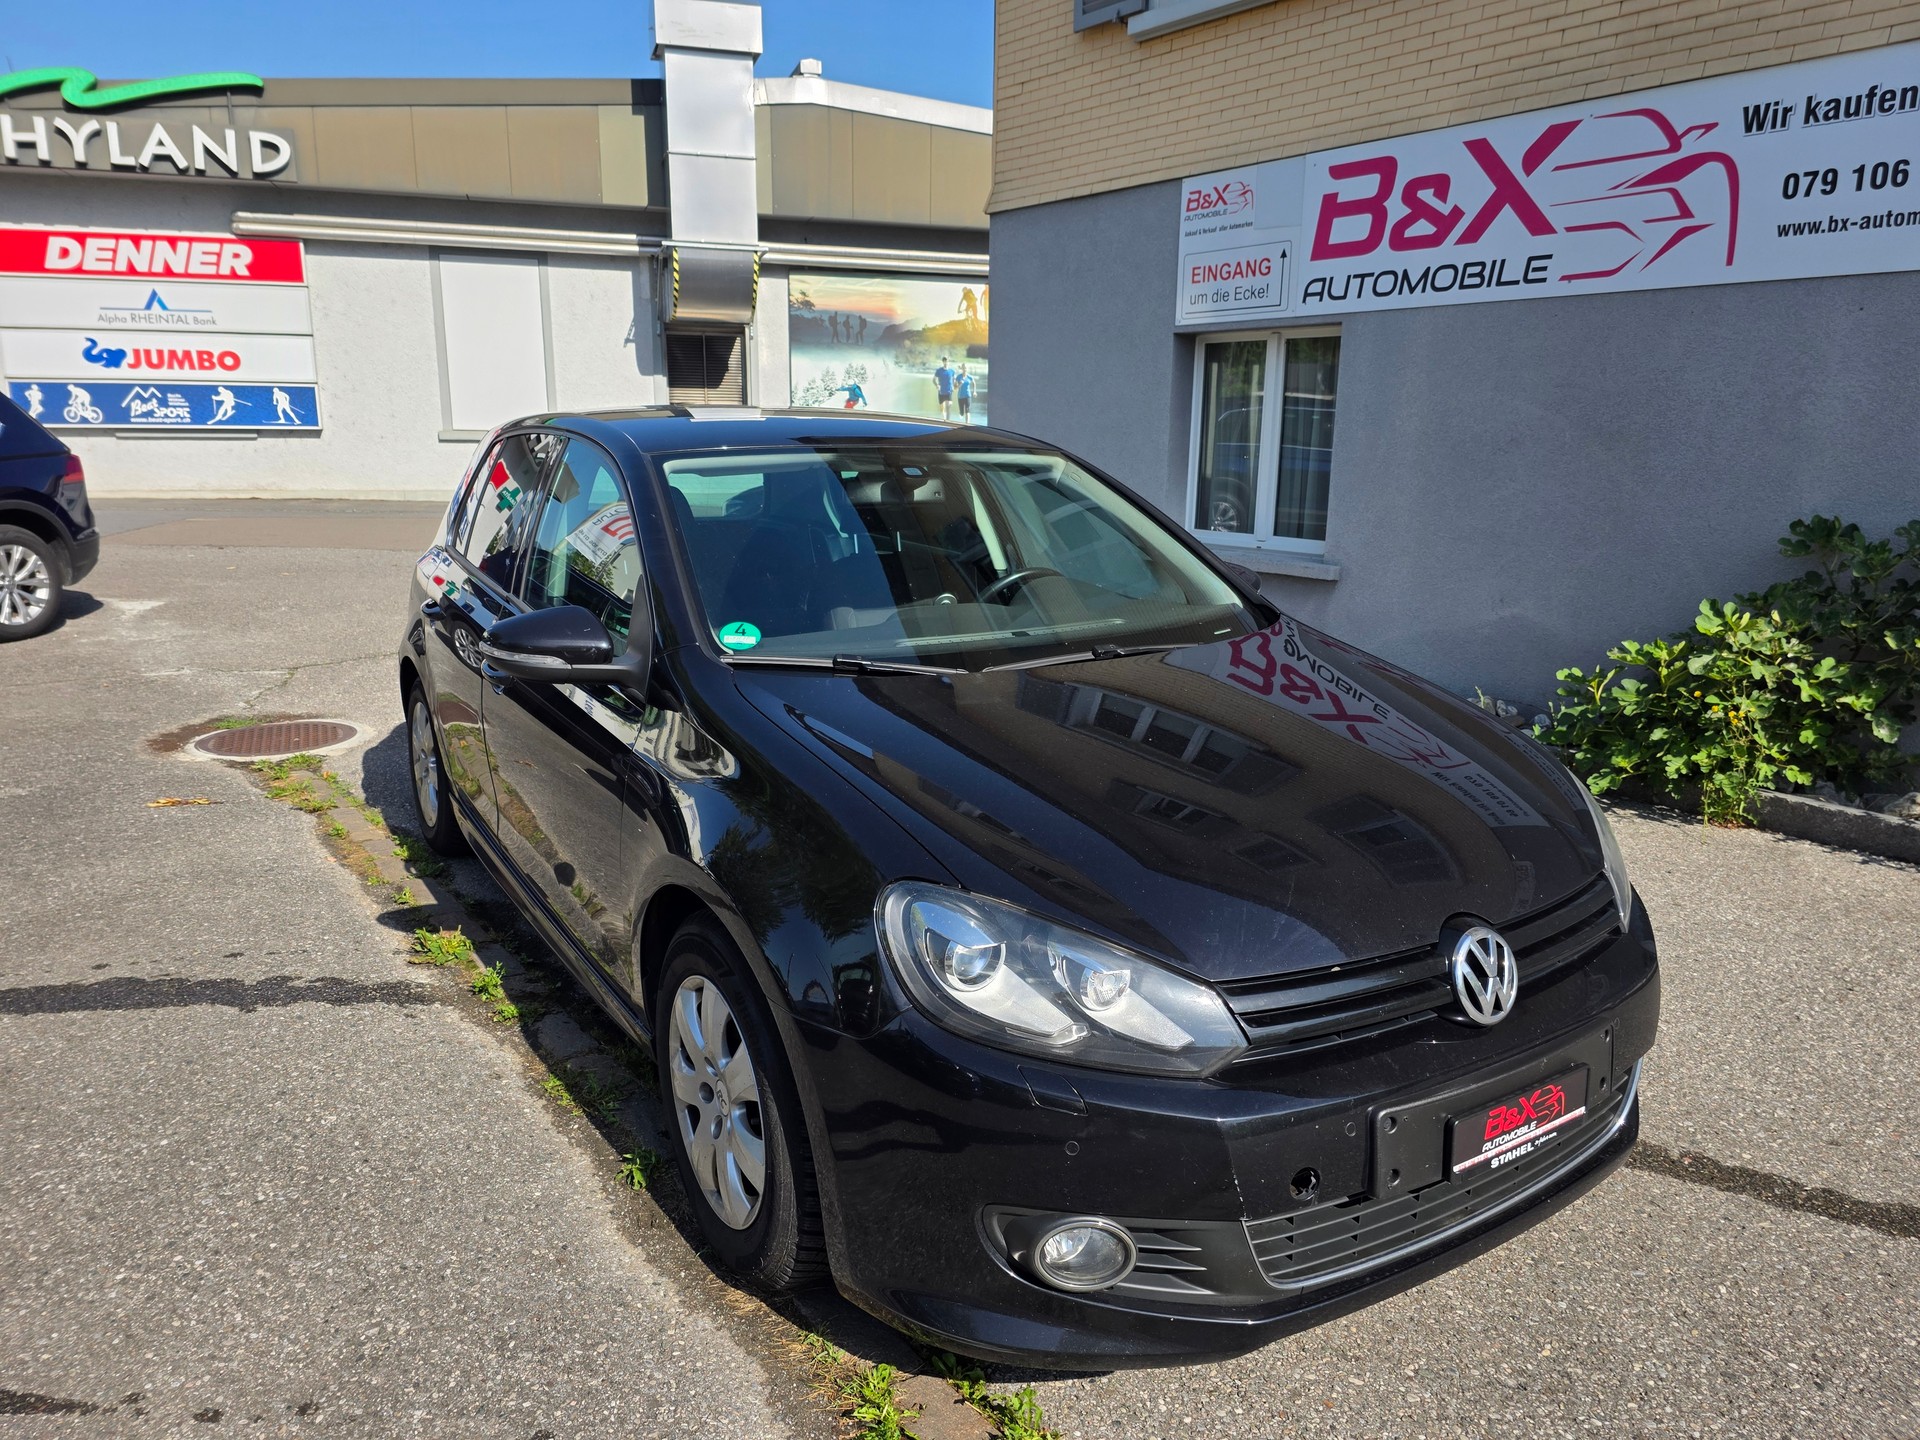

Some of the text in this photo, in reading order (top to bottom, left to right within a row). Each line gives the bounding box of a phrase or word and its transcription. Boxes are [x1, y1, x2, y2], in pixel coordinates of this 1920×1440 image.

[1743, 85, 1919, 133] Wir kaufen
[0, 113, 291, 174] HYLAND
[1310, 119, 1583, 262] B&X
[1782, 159, 1910, 200] 079 106
[1186, 184, 1231, 212] B&X
[1184, 208, 1228, 222] AUTOMOBILE
[1777, 210, 1920, 238] www.bx-autom
[44, 236, 253, 277] DENNER
[1191, 257, 1272, 284] EINGANG
[1302, 253, 1554, 305] AUTOMOBILE
[1189, 283, 1270, 305] um die Ecke!
[98, 313, 217, 326] Alpha RHEINTAL Bank
[127, 348, 241, 371] JUMBO
[734, 623, 747, 636] 4
[1484, 1090, 1541, 1140] B&X
[1482, 1121, 1537, 1152] AUTOMOBILE
[1490, 1142, 1534, 1169] STAHEL
